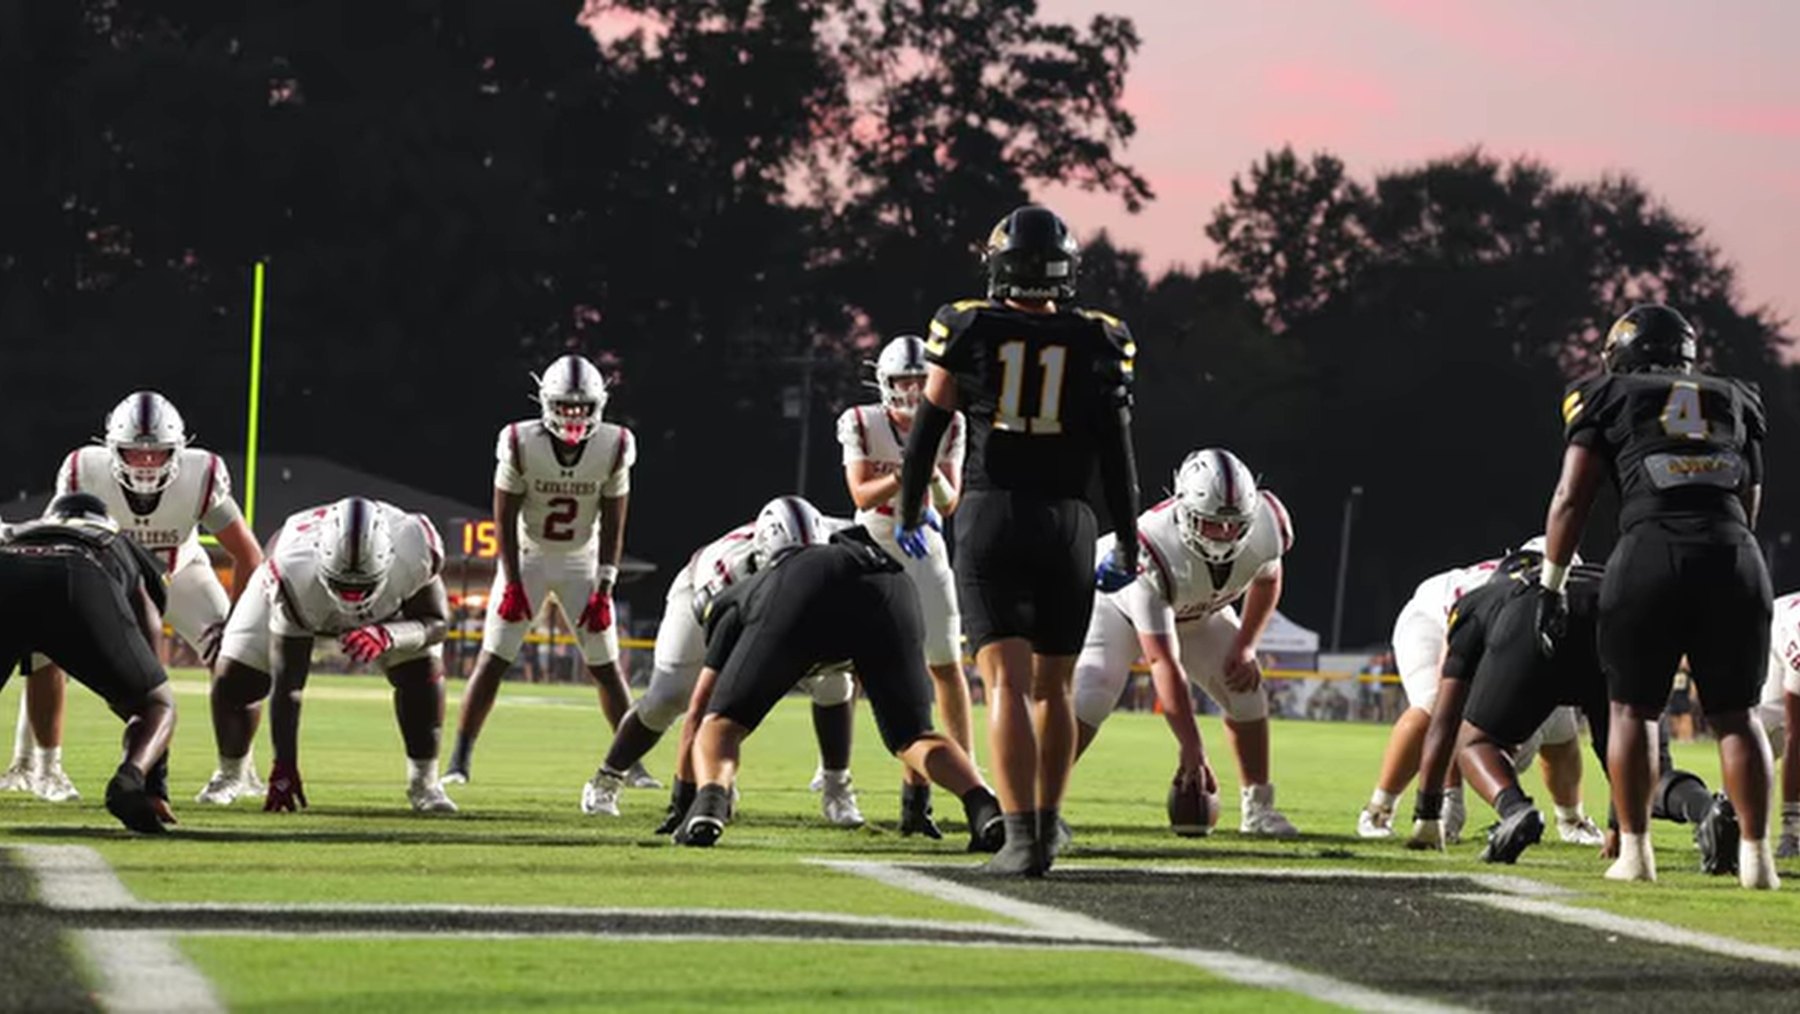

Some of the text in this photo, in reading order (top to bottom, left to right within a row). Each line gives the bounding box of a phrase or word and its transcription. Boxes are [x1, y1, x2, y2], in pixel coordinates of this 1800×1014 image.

[992, 340, 1067, 434] 11
[1659, 380, 1710, 440] 4
[463, 520, 499, 558] 15
[543, 497, 578, 541] 2
